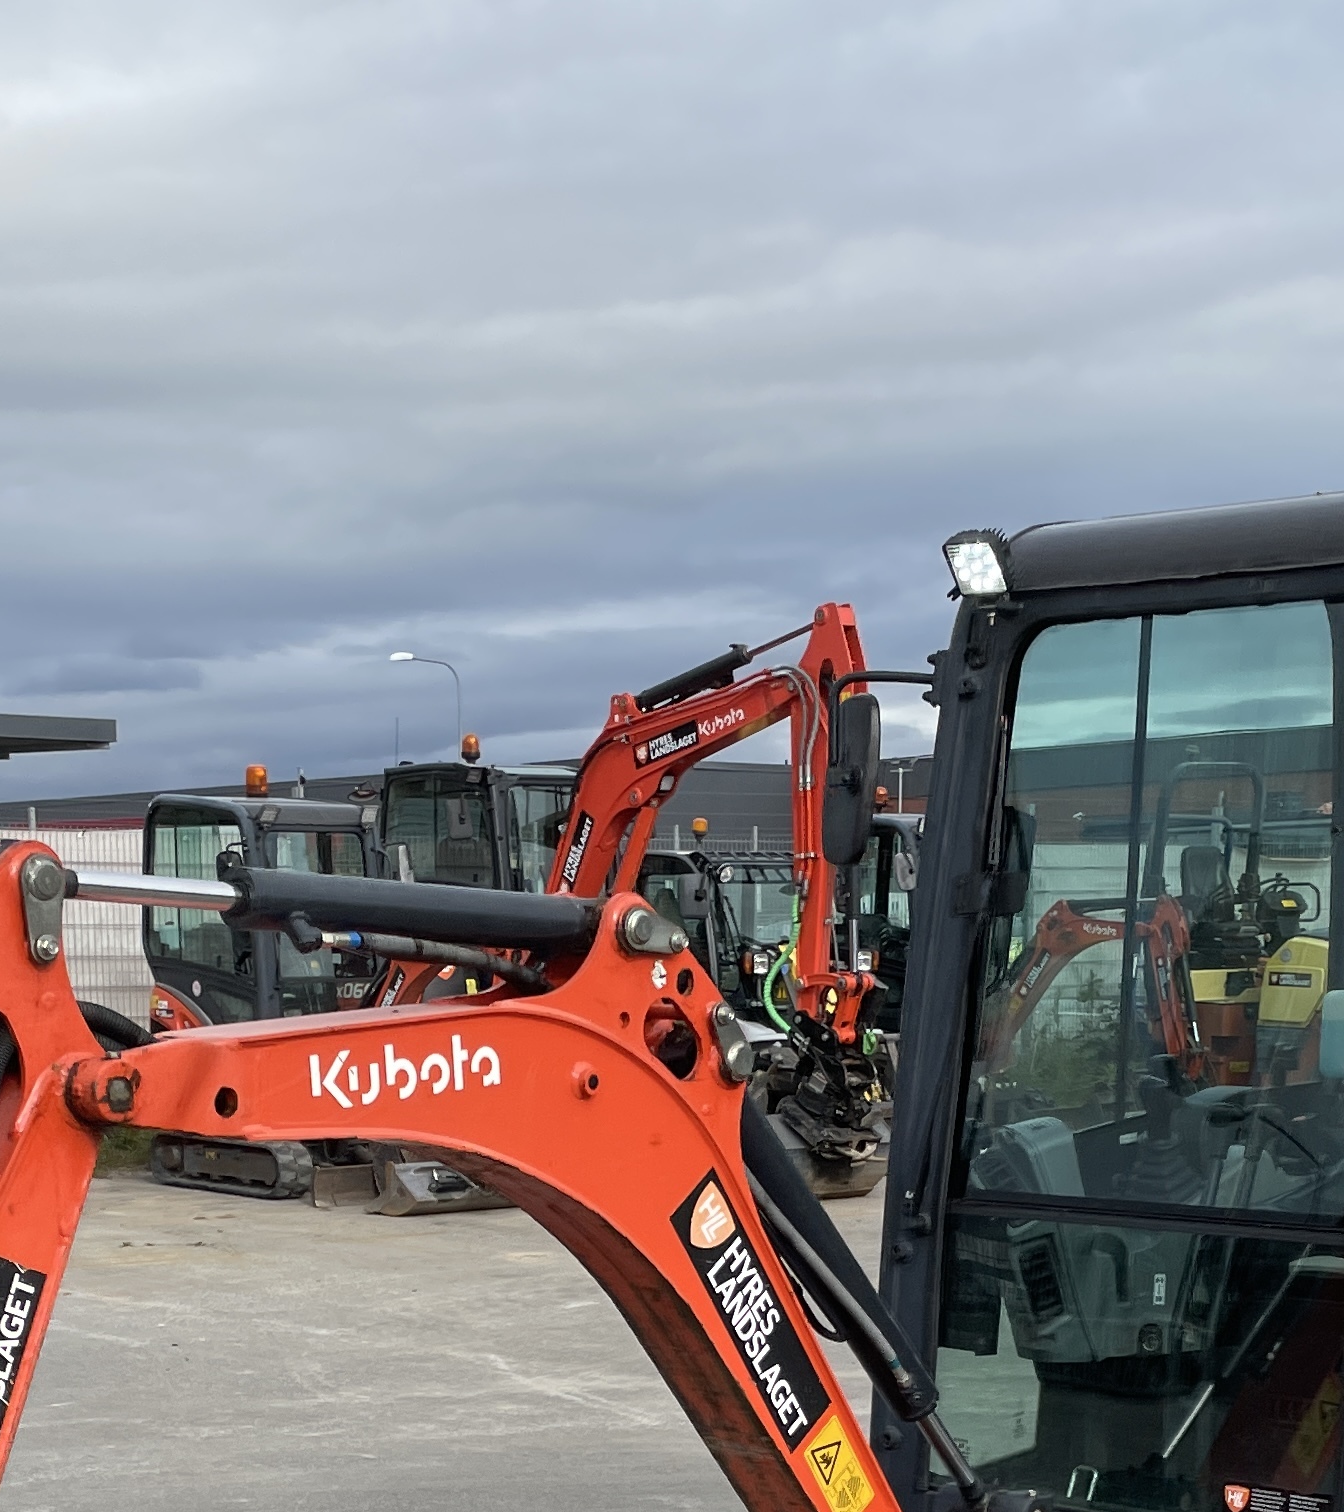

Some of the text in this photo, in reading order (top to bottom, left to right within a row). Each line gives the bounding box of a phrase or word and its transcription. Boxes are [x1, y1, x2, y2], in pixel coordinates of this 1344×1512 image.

[697, 708, 746, 737] Kubota
[309, 1034, 501, 1108] Kubota
[723, 1236, 781, 1337] HYRES
[706, 1256, 809, 1437] LANDSLAGET
